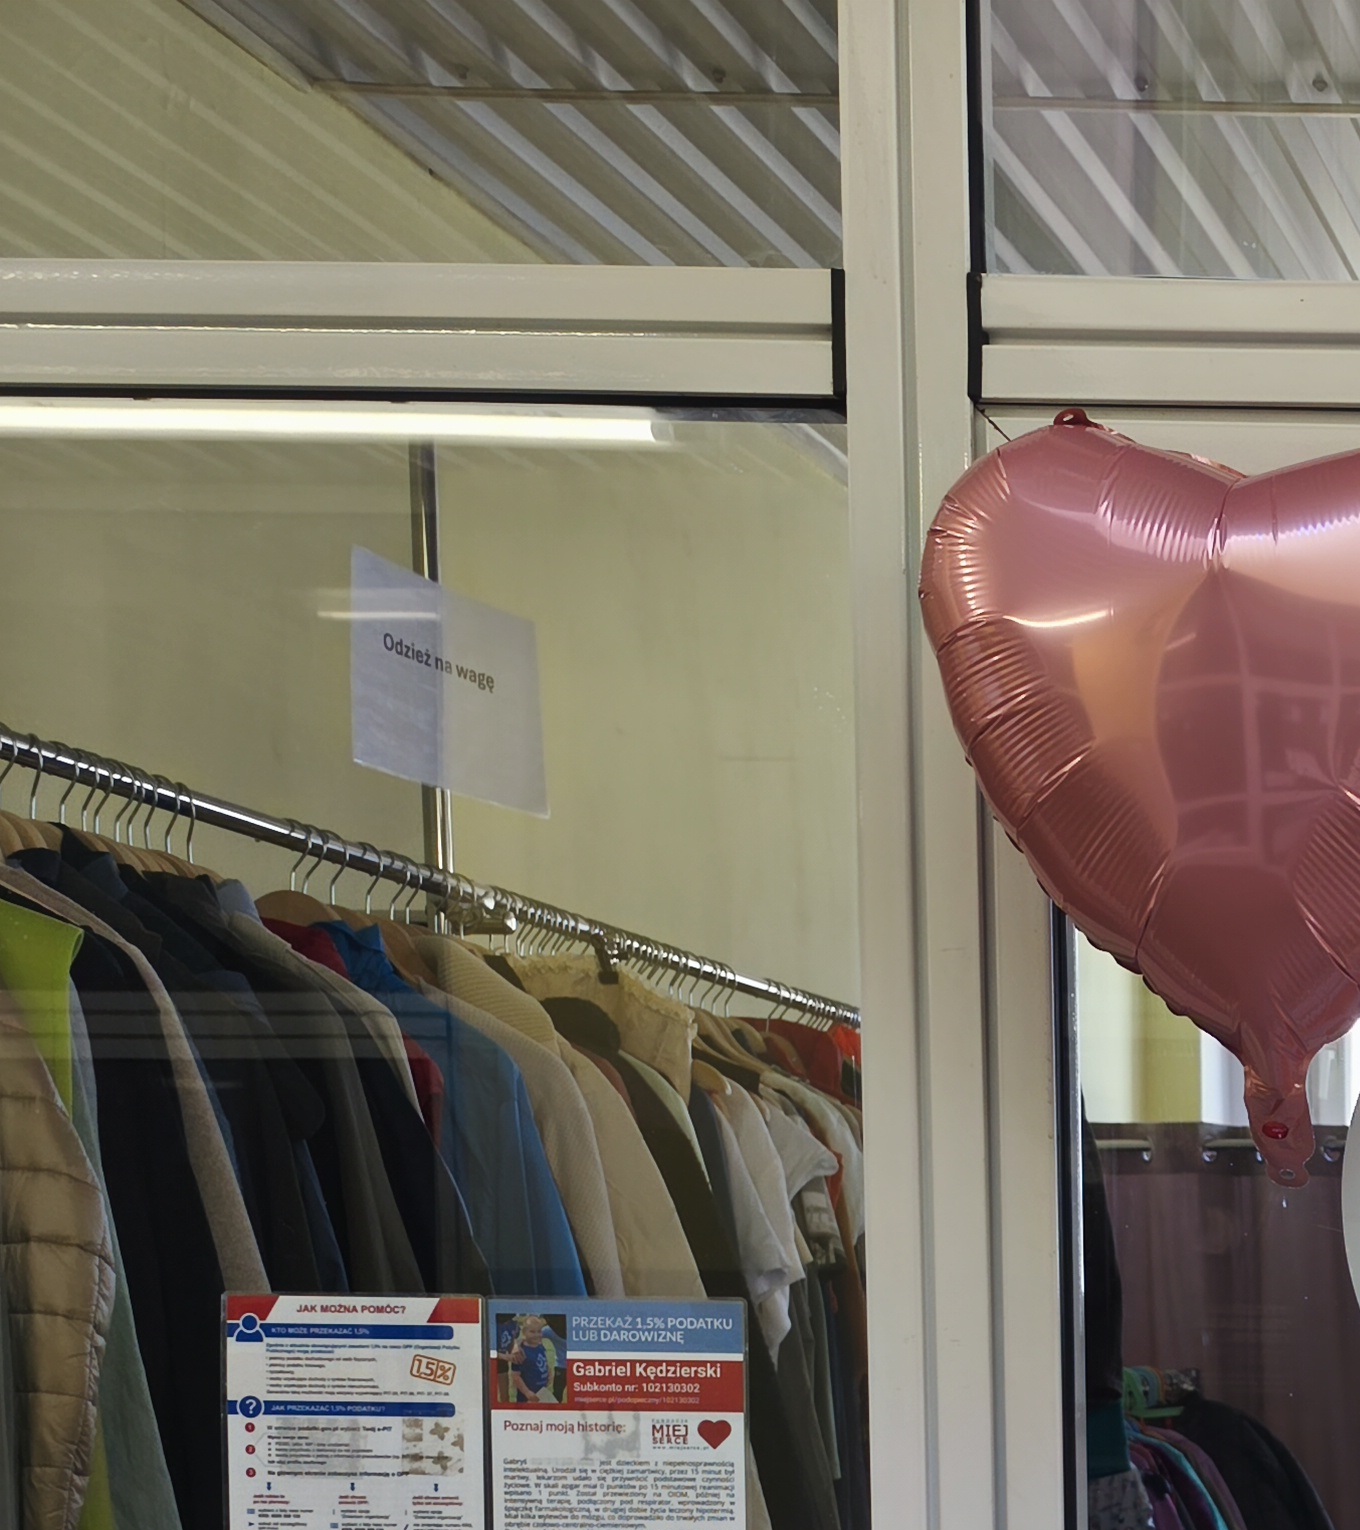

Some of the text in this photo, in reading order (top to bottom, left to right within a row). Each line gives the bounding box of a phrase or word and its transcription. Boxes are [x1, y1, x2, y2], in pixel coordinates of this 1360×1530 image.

[383, 632, 495, 693] Odzież na wagę
[296, 1304, 406, 1314] JAK MOŻNA POMÓC?
[572, 1315, 732, 1330] PRZEKAŻ 1,5% PODATKU
[572, 1330, 684, 1344] LUB DAROWIZNĘ
[572, 1362, 721, 1380] Gabriel Kędzierski
[574, 1382, 700, 1393] Subkonto nr: 102130302
[504, 1420, 626, 1434] Poznaj moją historię:
[652, 1424, 688, 1437] MIEJ
